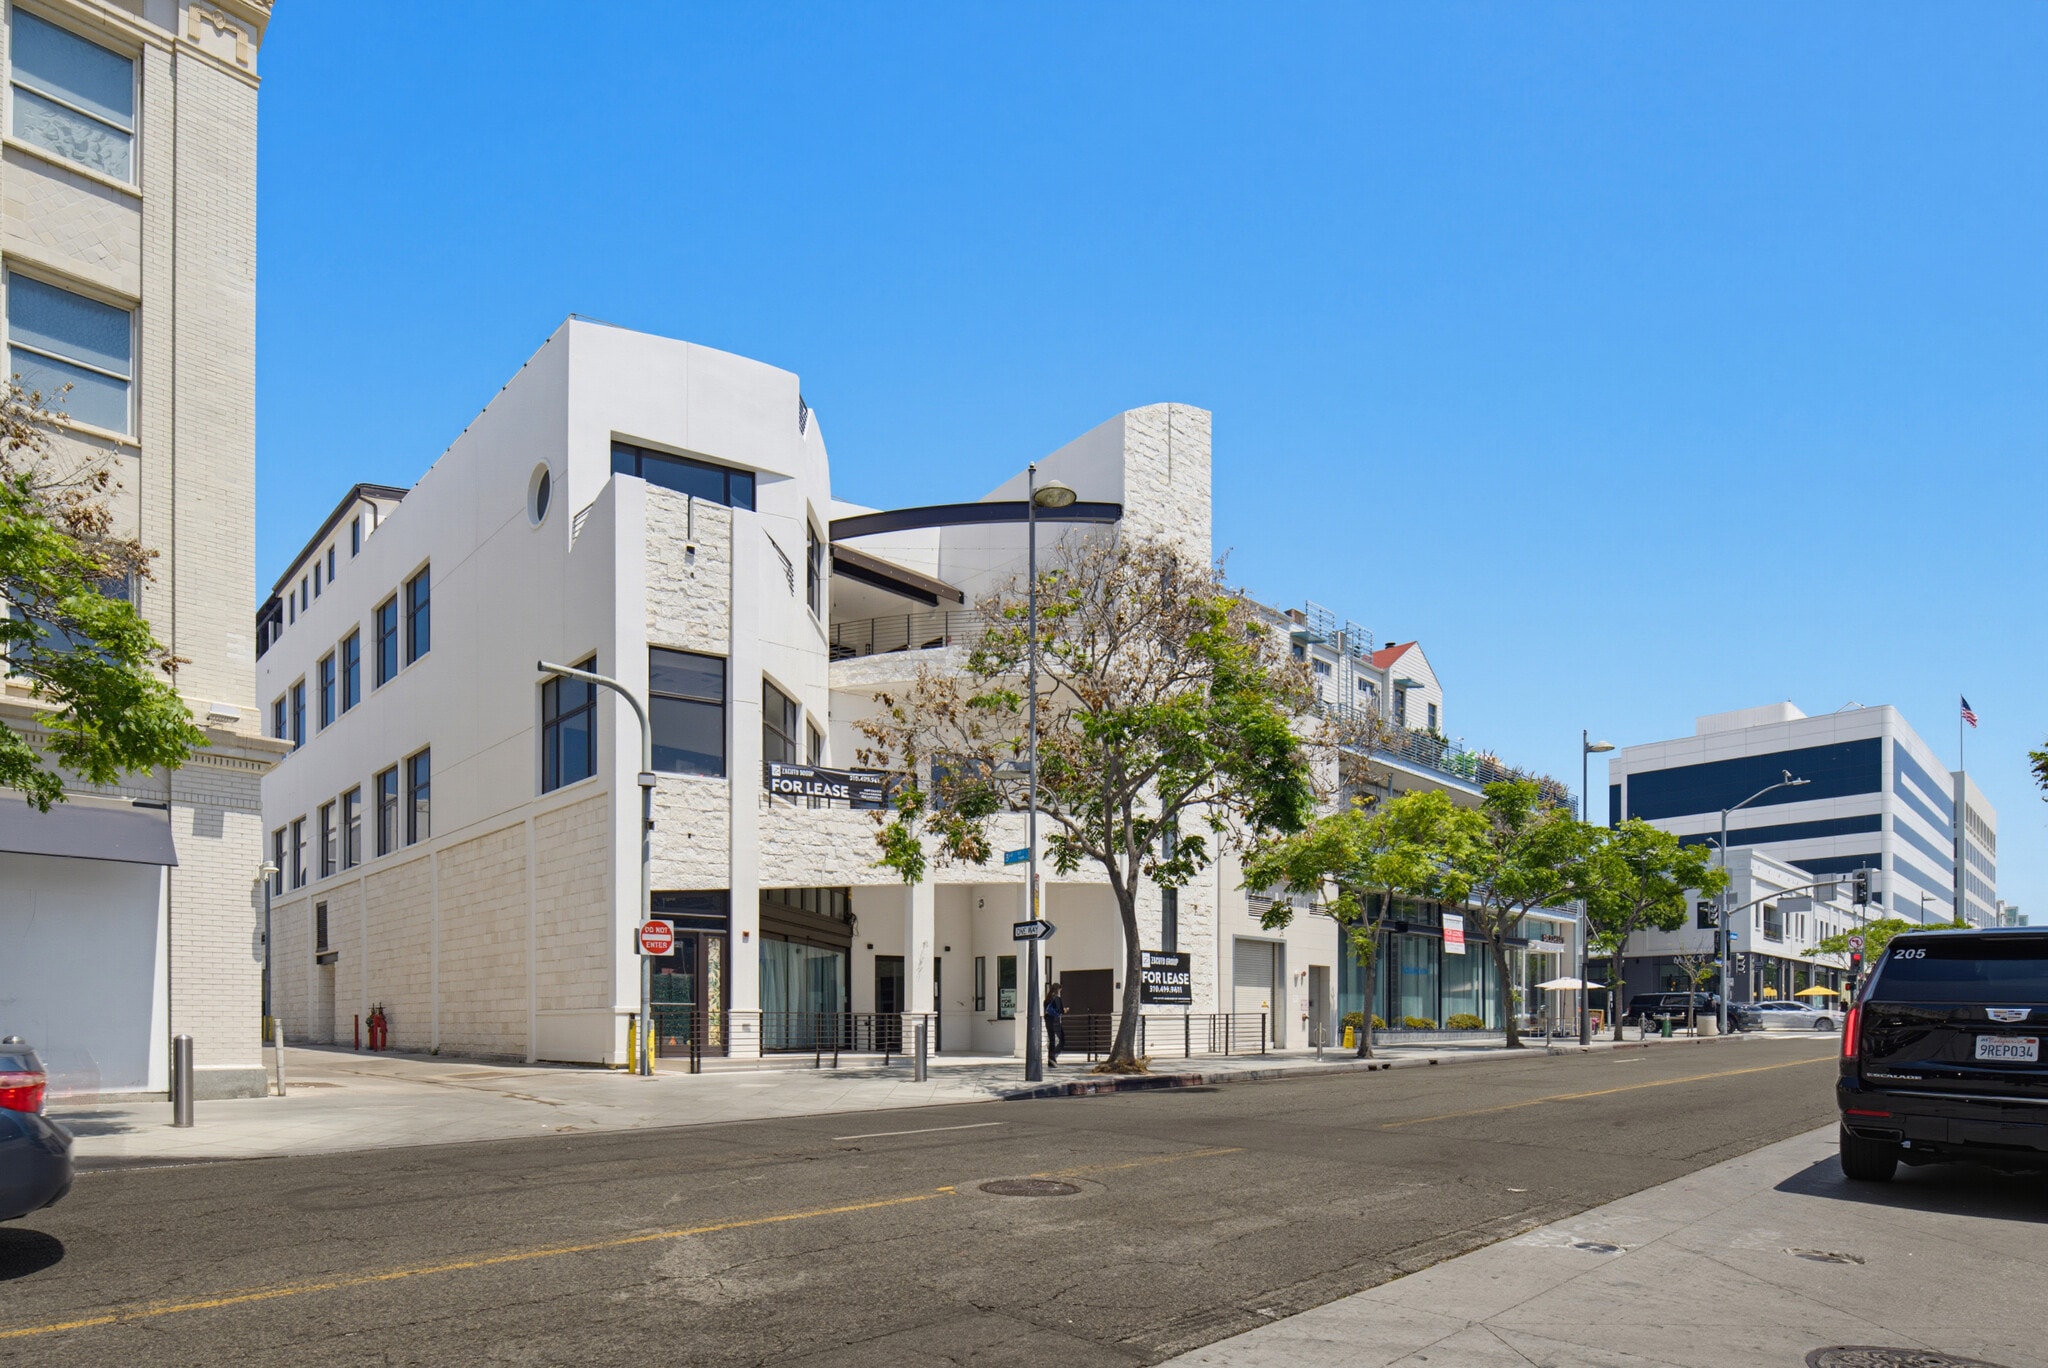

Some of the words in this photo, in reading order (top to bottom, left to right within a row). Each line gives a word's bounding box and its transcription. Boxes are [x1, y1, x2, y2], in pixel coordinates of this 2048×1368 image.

[771, 779, 803, 794] FOR
[806, 782, 849, 798] LEASE
[1016, 928, 1026, 936] ONE
[1027, 926, 1038, 934] WAY
[646, 941, 668, 949] ENTER
[1893, 949, 1927, 959] 205
[1142, 971, 1162, 984] FOR
[1162, 972, 1189, 985] LEASE
[1980, 1045, 2033, 1058] 9REP034
[1866, 1072, 1922, 1080] ESCALADE
